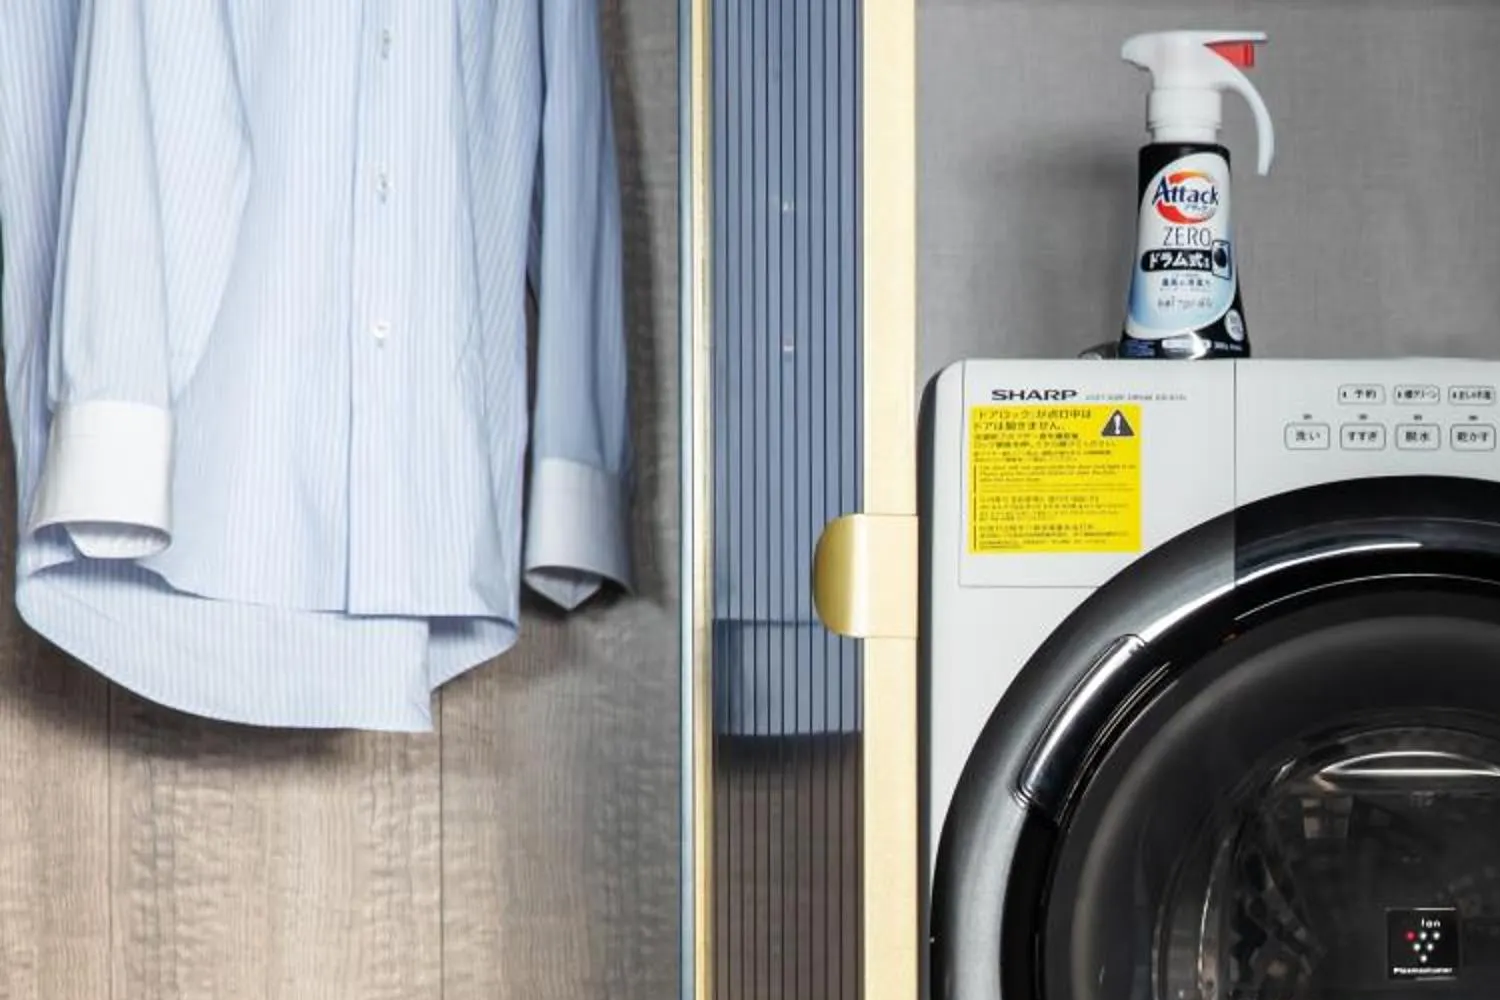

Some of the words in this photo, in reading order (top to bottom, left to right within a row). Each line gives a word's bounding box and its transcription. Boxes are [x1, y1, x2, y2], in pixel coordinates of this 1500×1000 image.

[1152, 176, 1219, 206] Attack
[1163, 226, 1212, 247] ZERO
[991, 389, 1078, 401] SHARP
[1347, 431, 1378, 442] すすぎ
[1405, 431, 1430, 442] 脱水
[1421, 917, 1441, 929] Ion
